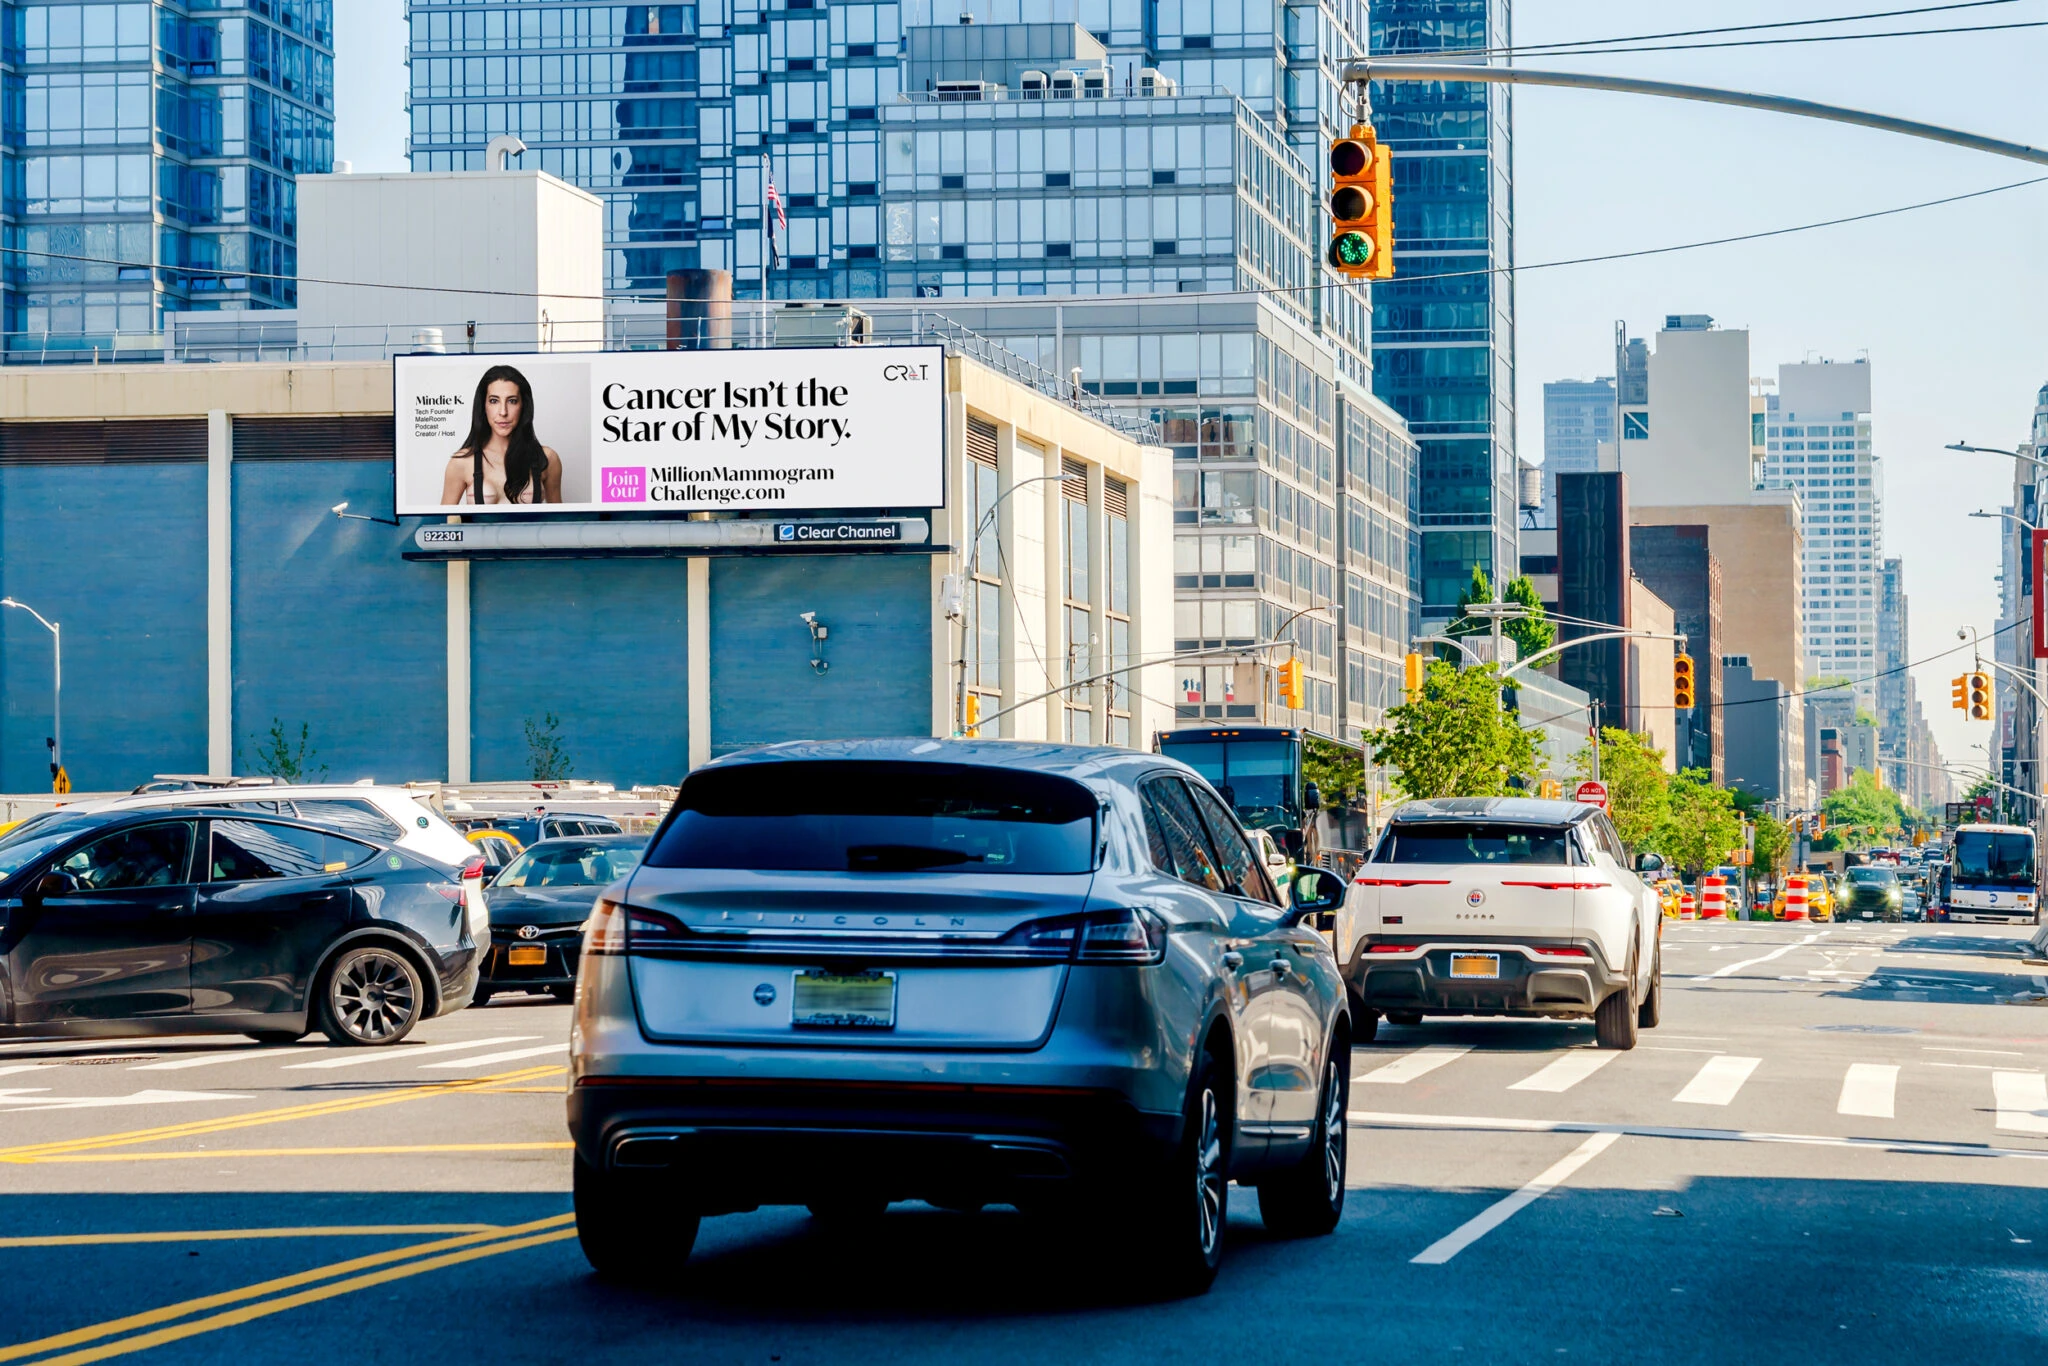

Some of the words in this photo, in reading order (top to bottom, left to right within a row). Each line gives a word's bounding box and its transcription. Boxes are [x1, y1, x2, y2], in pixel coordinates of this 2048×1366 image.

[415, 395, 452, 406] Mindie
[453, 395, 465, 405] K.
[602, 383, 716, 410] Cancer
[724, 381, 788, 408] Isn’t
[796, 377, 849, 407] the
[602, 415, 666, 442] Star
[672, 411, 705, 442] of
[711, 413, 758, 448] My
[764, 412, 852, 447] Story.
[606, 471, 639, 488] Join
[650, 466, 834, 485] MillionMammogram
[610, 486, 639, 499] our
[650, 484, 785, 504] Challenge.com
[424, 531, 462, 541] 922301
[797, 525, 836, 539] Clear
[837, 525, 895, 538] Channel
[721, 910, 965, 927] LINCOLN
